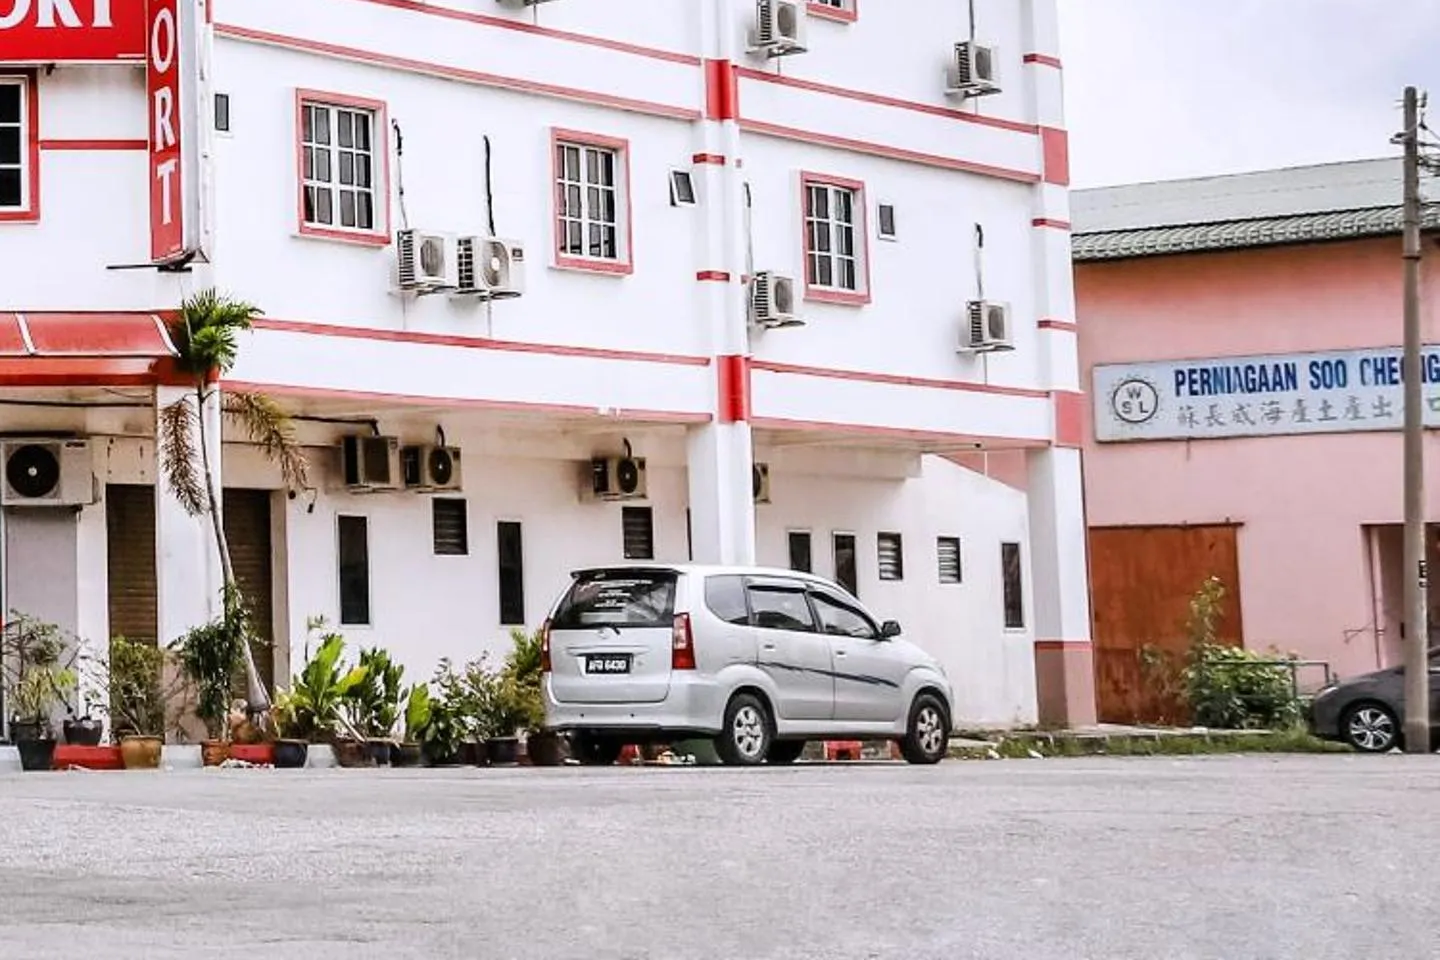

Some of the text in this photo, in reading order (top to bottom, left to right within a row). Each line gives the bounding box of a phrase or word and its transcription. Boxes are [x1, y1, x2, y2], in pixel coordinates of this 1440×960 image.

[1174, 362, 1298, 397] PERNIAGAAN
[1309, 358, 1347, 390] SOO
[1126, 386, 1142, 399] W
[1121, 401, 1149, 414] S L
